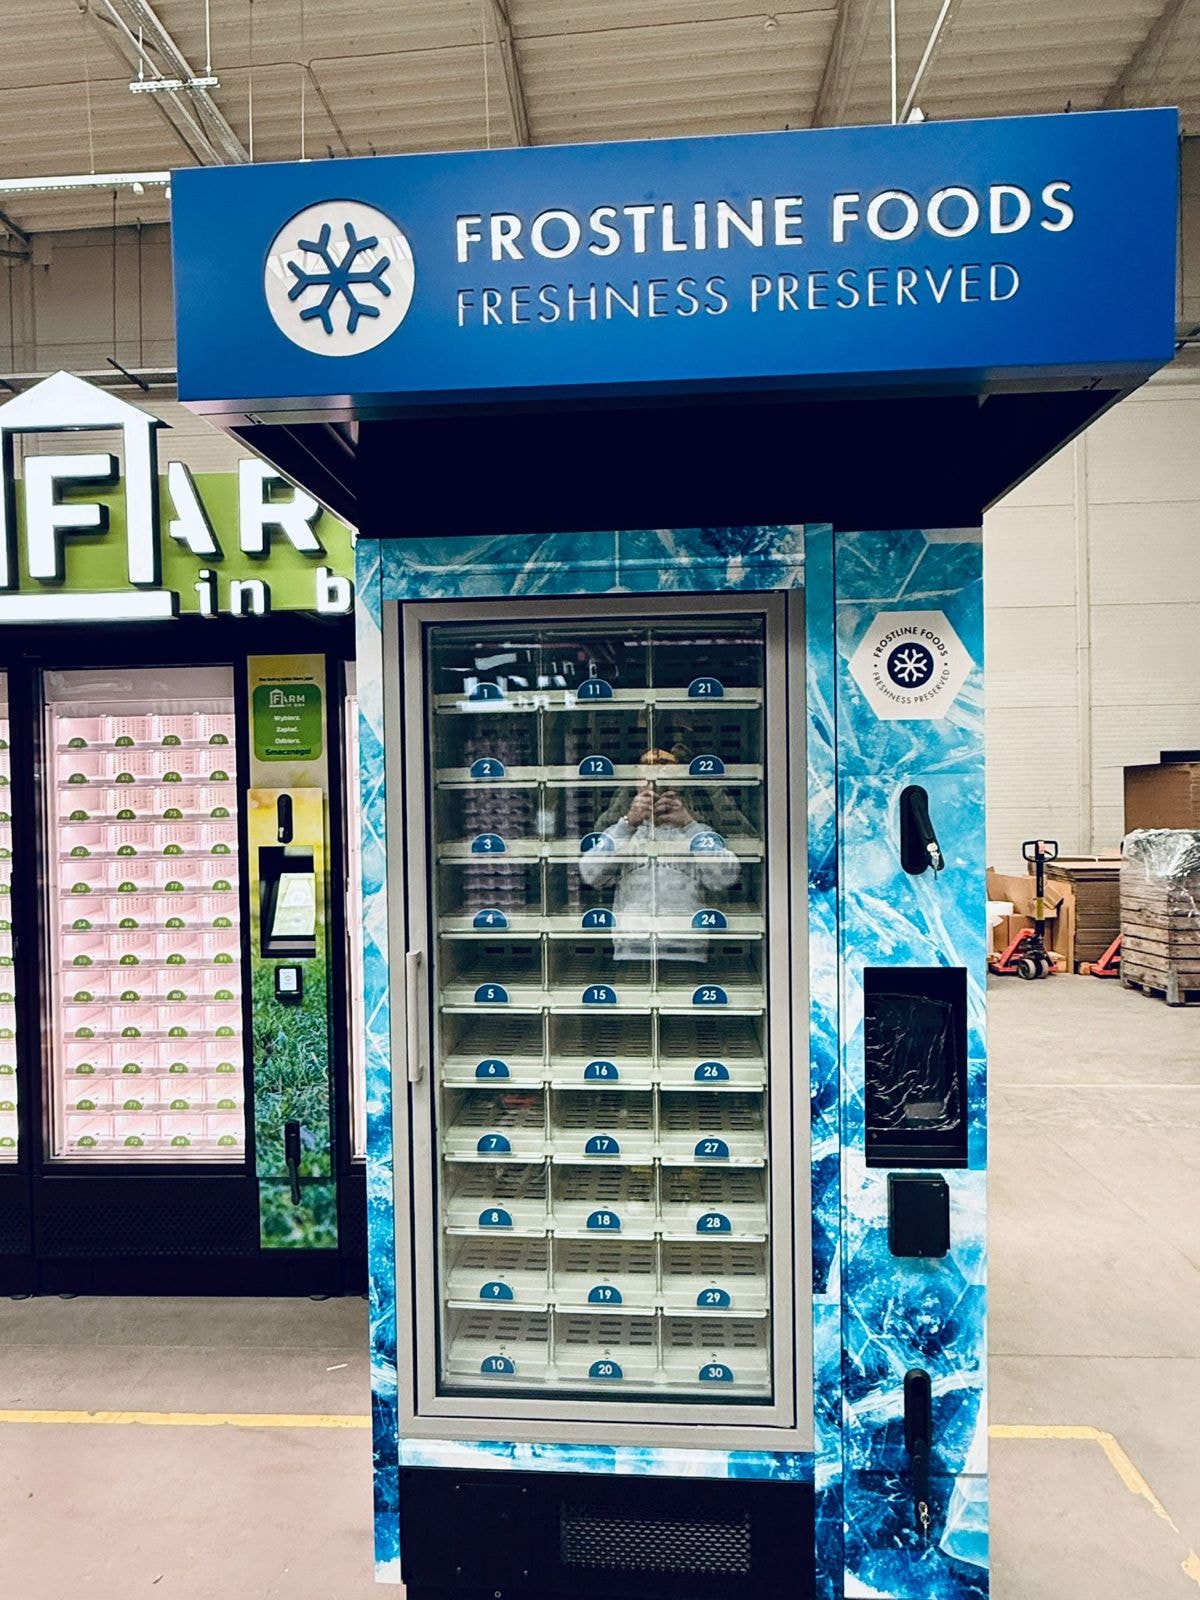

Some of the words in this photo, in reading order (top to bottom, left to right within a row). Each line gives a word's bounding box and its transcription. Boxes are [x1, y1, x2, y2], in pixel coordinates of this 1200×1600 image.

[456, 196, 803, 263] FROSTLINE
[832, 181, 1074, 243] FOODS
[457, 276, 728, 327] FRESHNESS
[751, 262, 1020, 312] PRESERVED
[24, 454, 356, 580] FAR
[194, 568, 267, 616] in
[873, 626, 919, 658] FROSTLINE
[920, 628, 949, 657] FOODS
[588, 684, 600, 695] 11
[698, 683, 711, 693] 21
[872, 671, 912, 705] FRESHNESS
[914, 669, 950, 703] PRESERVED
[483, 688, 488, 698] 1
[483, 763, 491, 774] 2
[590, 761, 603, 772] 12
[699, 760, 714, 771] 22
[483, 838, 492, 849] 3
[699, 836, 715, 849] 23
[486, 913, 494, 924] 4
[592, 913, 606, 924] 14
[701, 914, 716, 925] 24
[487, 988, 494, 999] 5
[593, 989, 606, 1000] 15
[702, 990, 717, 1001] 25
[488, 1064, 496, 1074] 6
[594, 1065, 608, 1076] 16
[704, 1066, 718, 1077] 26
[490, 1138, 497, 1148] 7
[596, 1139, 609, 1150] 17
[704, 1142, 719, 1153] 27
[491, 1212, 499, 1223] 8
[597, 1214, 611, 1225] 18
[706, 1217, 721, 1228] 28
[493, 1285, 500, 1296] 9
[598, 1289, 612, 1300] 19
[706, 1292, 721, 1303] 29
[491, 1359, 505, 1370] 10
[598, 1364, 613, 1375] 20
[708, 1367, 723, 1378] 30
